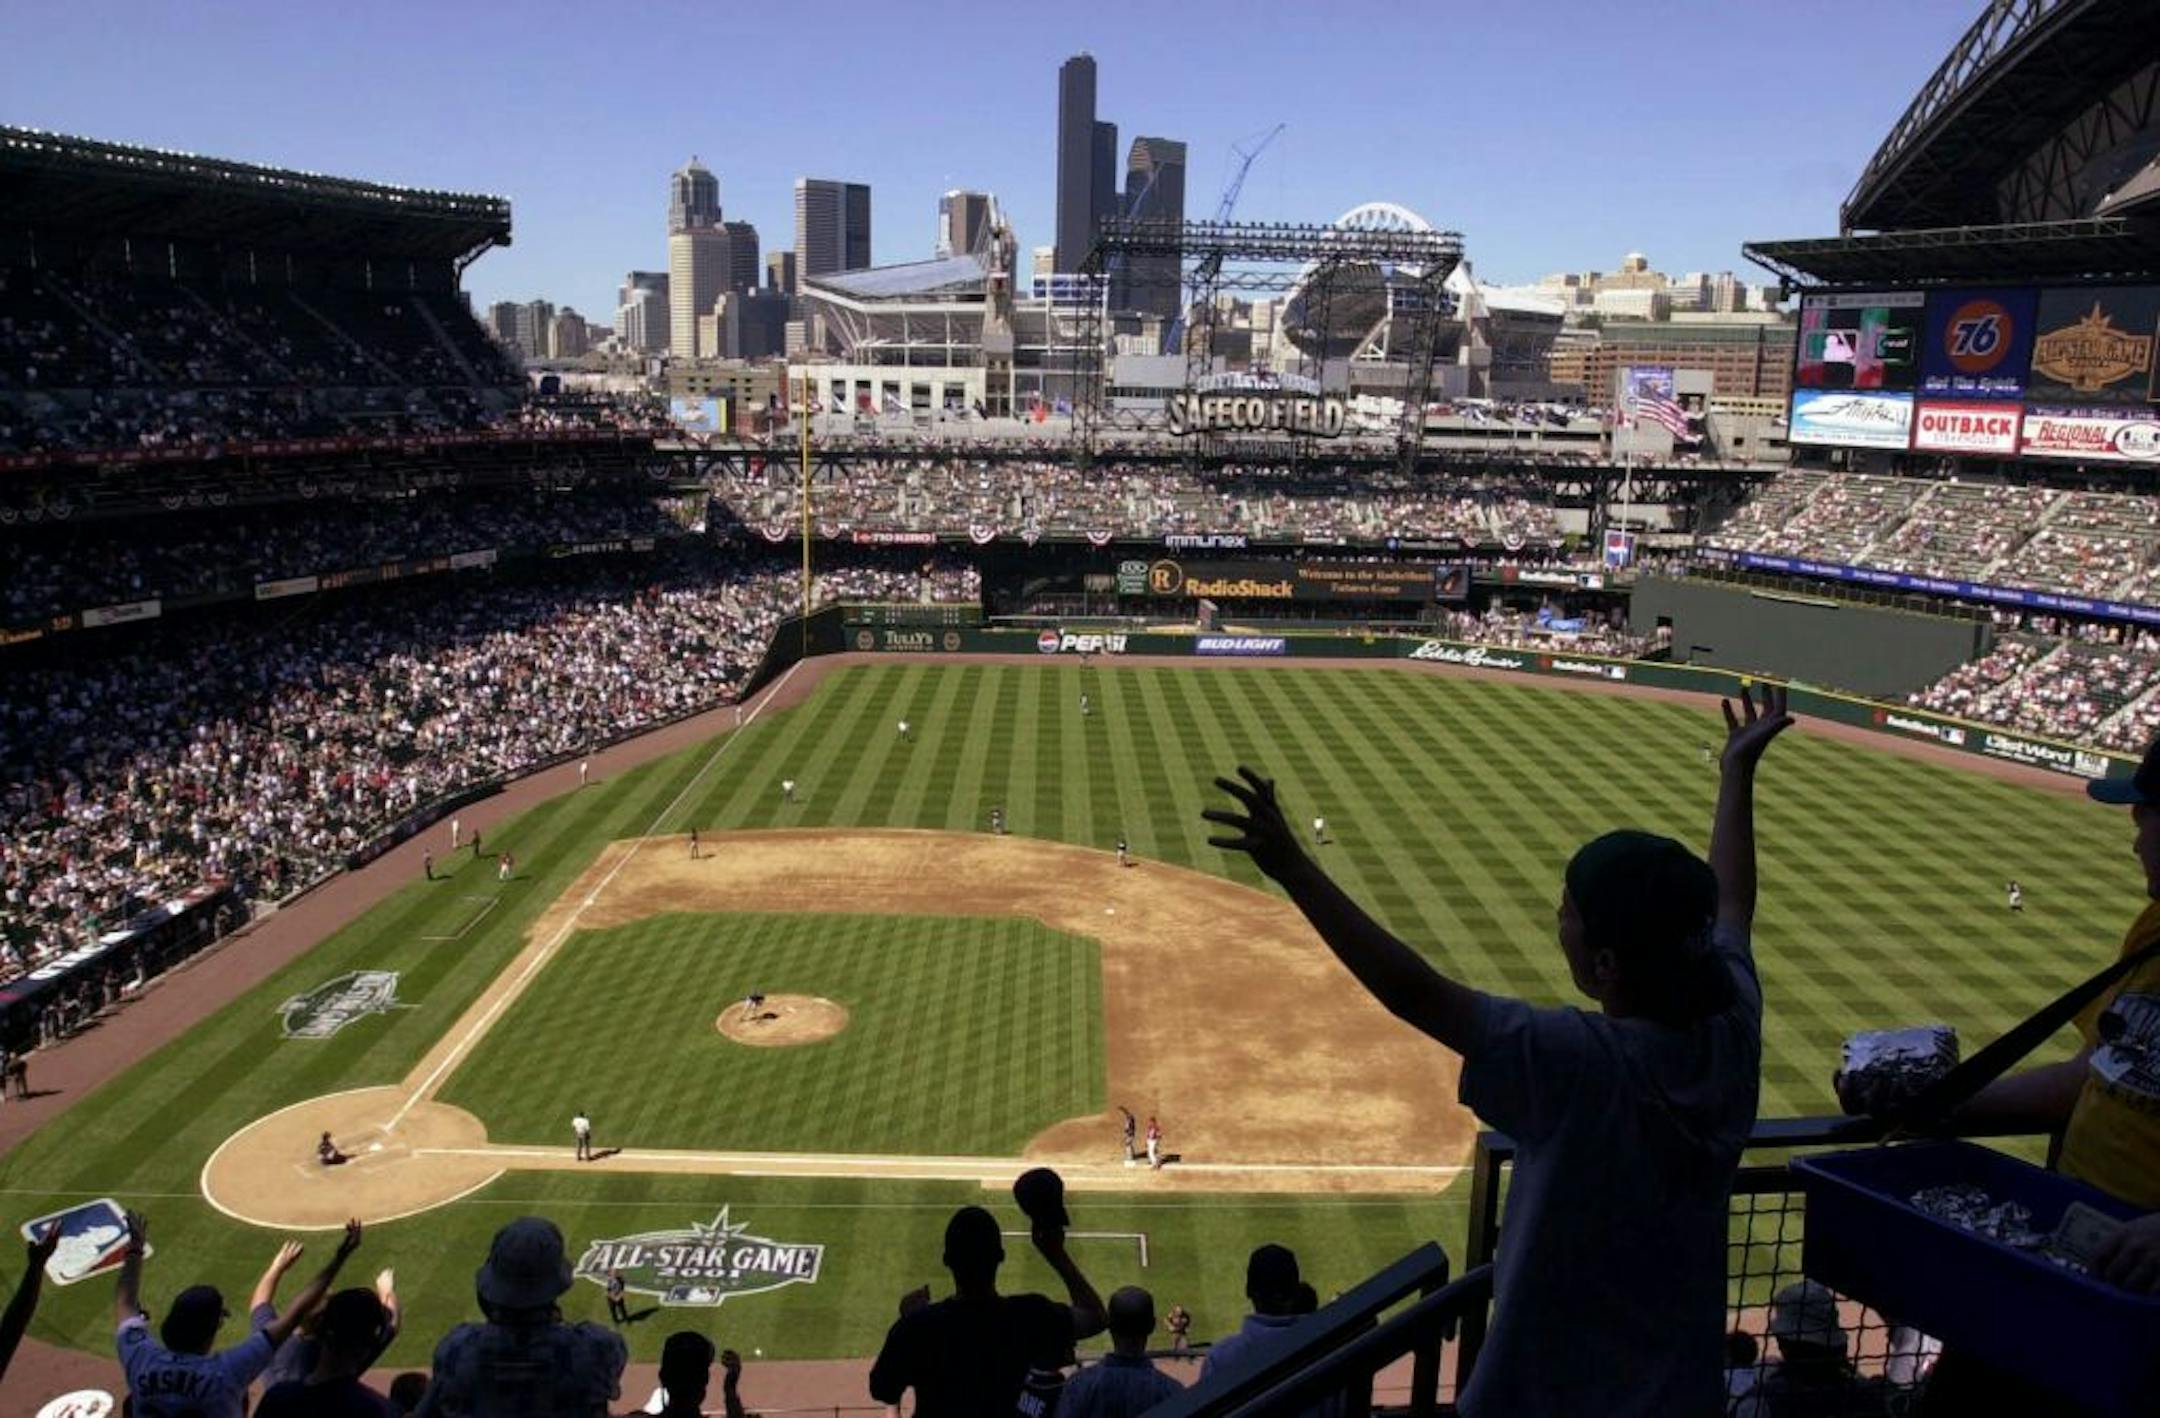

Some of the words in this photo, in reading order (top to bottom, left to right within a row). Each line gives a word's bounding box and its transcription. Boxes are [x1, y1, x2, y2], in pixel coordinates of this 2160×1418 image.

[1951, 314, 2001, 356] 76
[1169, 394, 1265, 437] SAFECO
[1271, 396, 1345, 438] FIELD
[1922, 414, 2012, 436] OUTBACK
[1165, 535, 1247, 548] immunex
[1154, 569, 1170, 588] R
[1186, 578, 1294, 598] RadioShack
[1198, 637, 1236, 650] BUD
[1238, 637, 1284, 650] LIGHT
[587, 1244, 728, 1271] ALL-STAR
[731, 1247, 817, 1277] GAME
[656, 1267, 742, 1279] 2001
